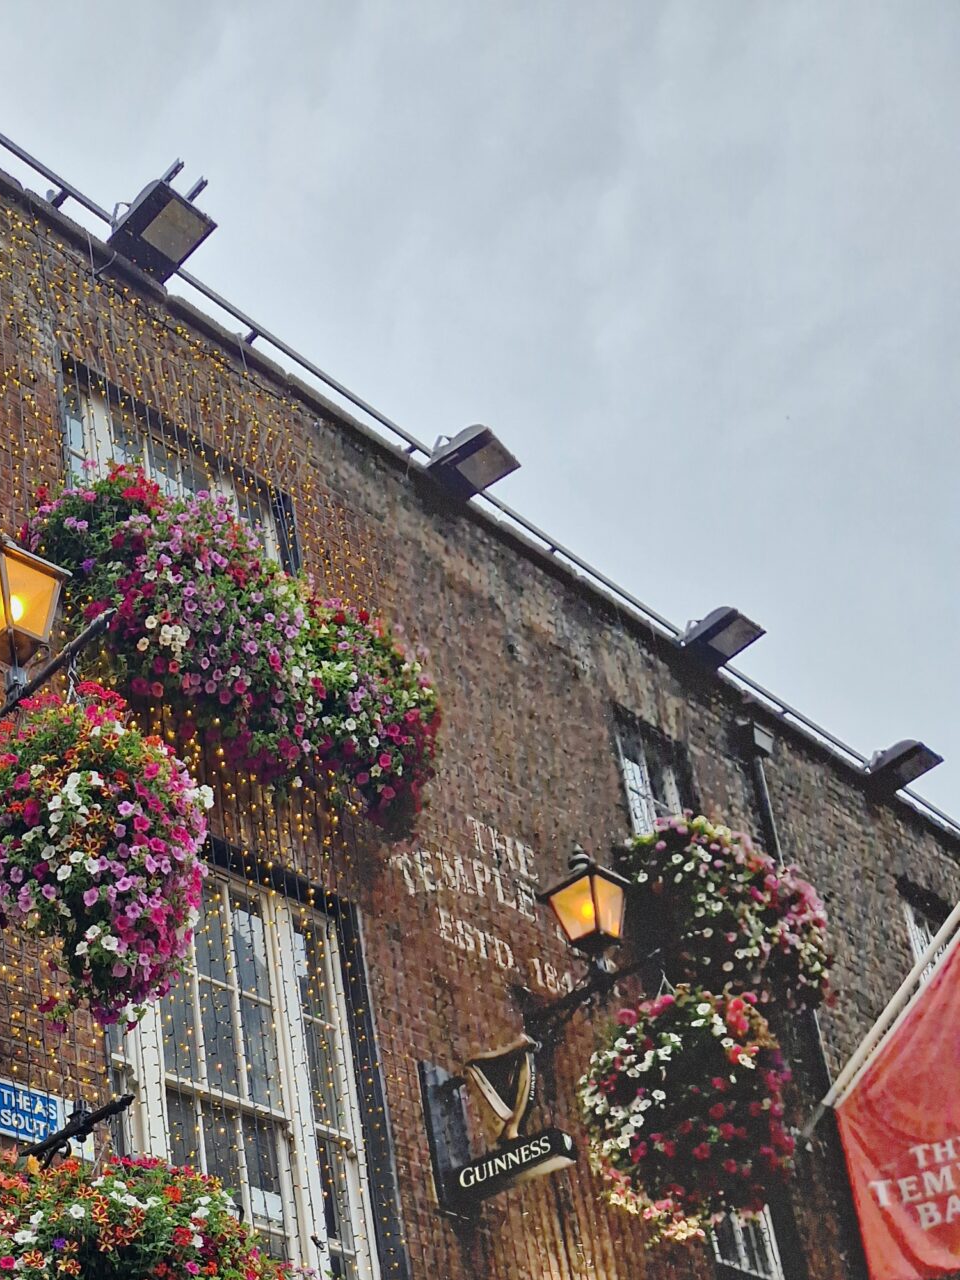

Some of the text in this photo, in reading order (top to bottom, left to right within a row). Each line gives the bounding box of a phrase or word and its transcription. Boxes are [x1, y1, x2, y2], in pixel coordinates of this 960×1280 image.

[0, 1087, 58, 1120] THEAS
[0, 1109, 58, 1141] SOUTH
[459, 1136, 551, 1188] GUINNESS
[909, 1136, 960, 1169] TH
[868, 1162, 960, 1208] TEM
